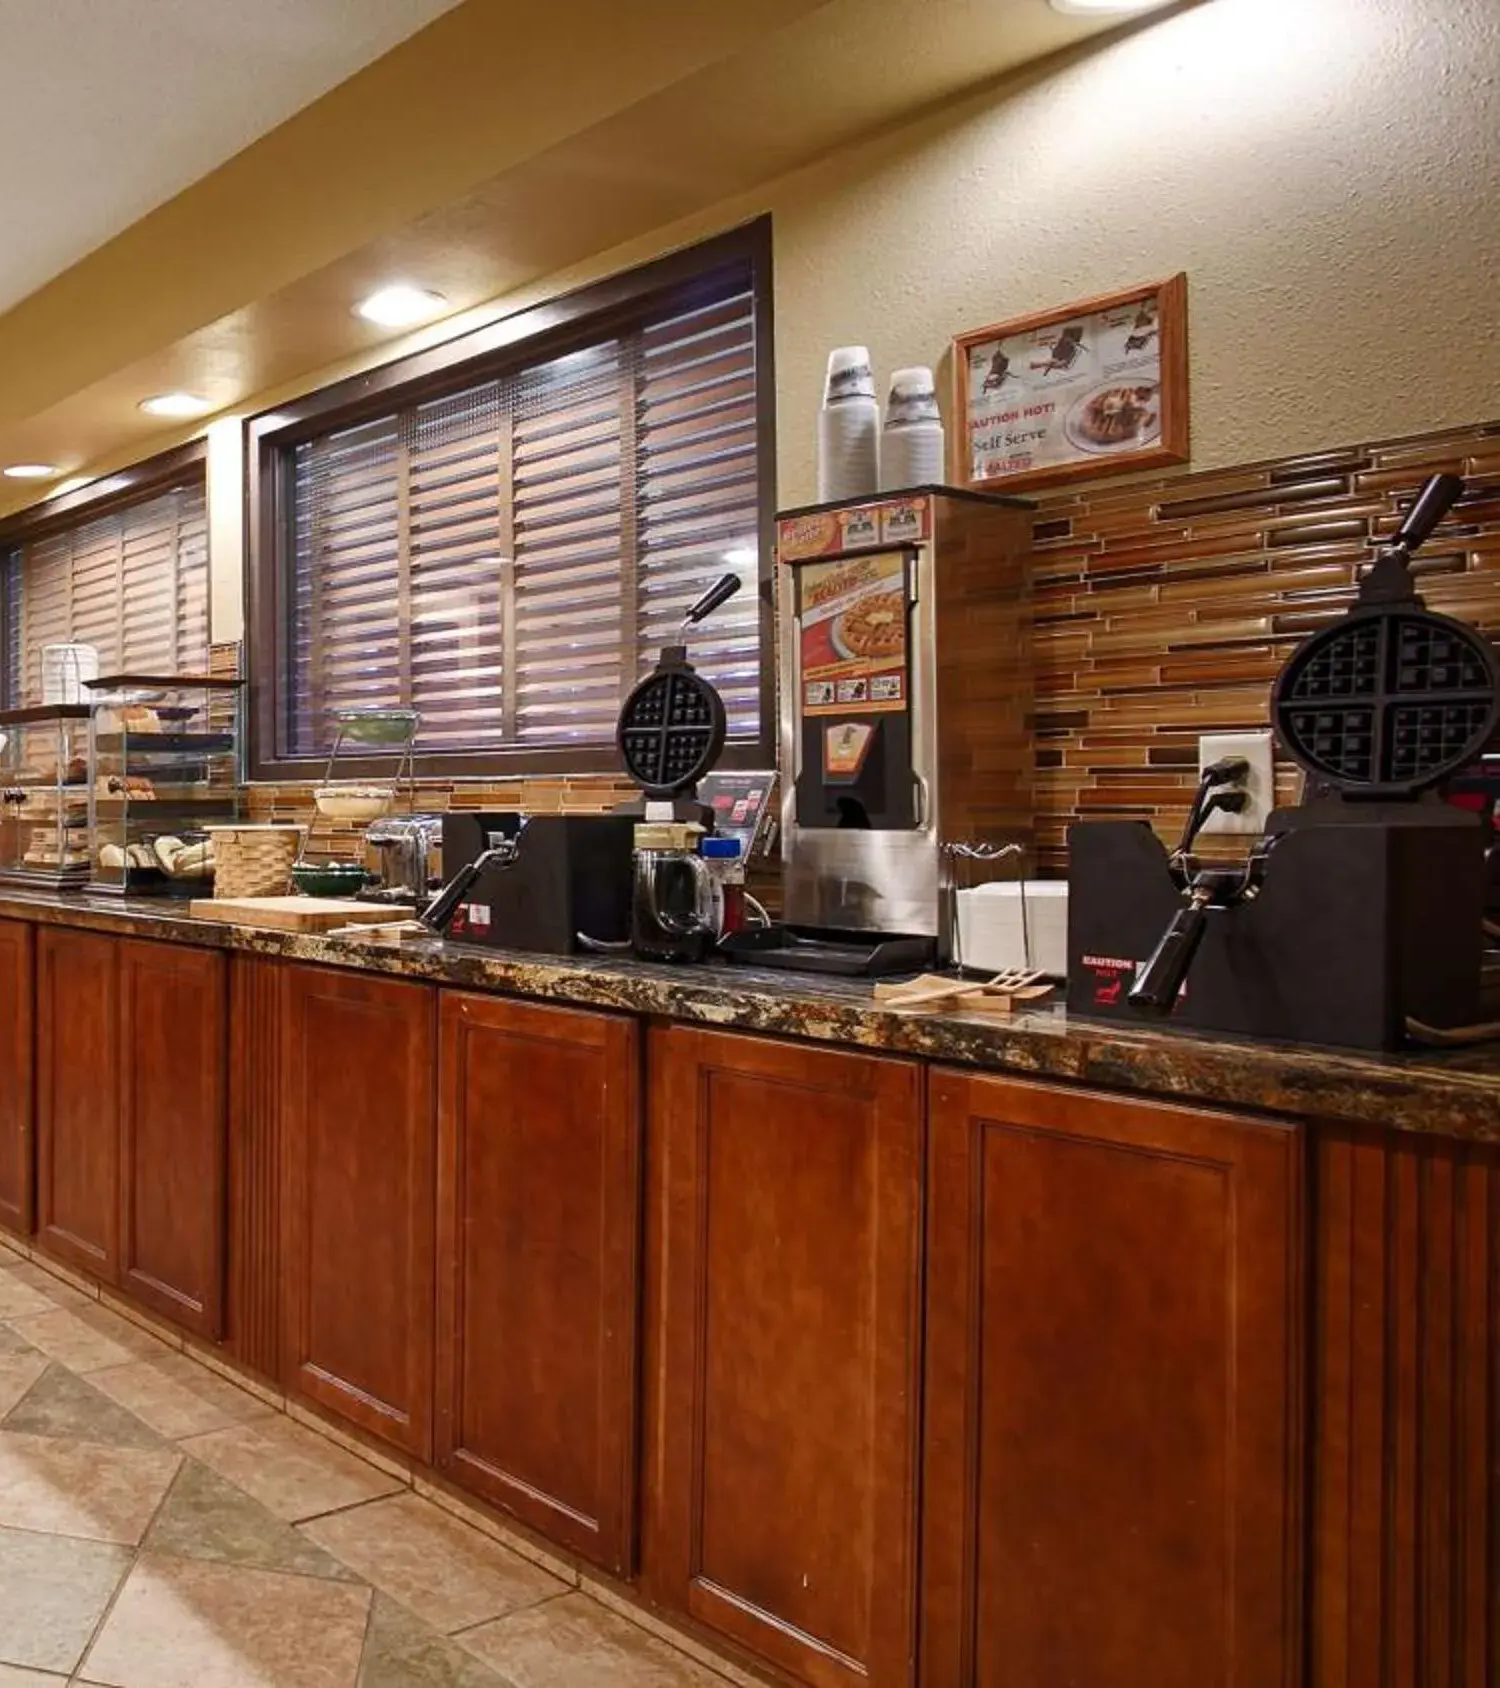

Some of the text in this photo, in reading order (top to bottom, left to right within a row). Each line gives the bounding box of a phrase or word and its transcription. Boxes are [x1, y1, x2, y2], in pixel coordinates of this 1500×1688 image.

[1023, 401, 1056, 419] HOT!
[1004, 428, 1048, 447] Serve
[1082, 955, 1133, 969] CAUTION
